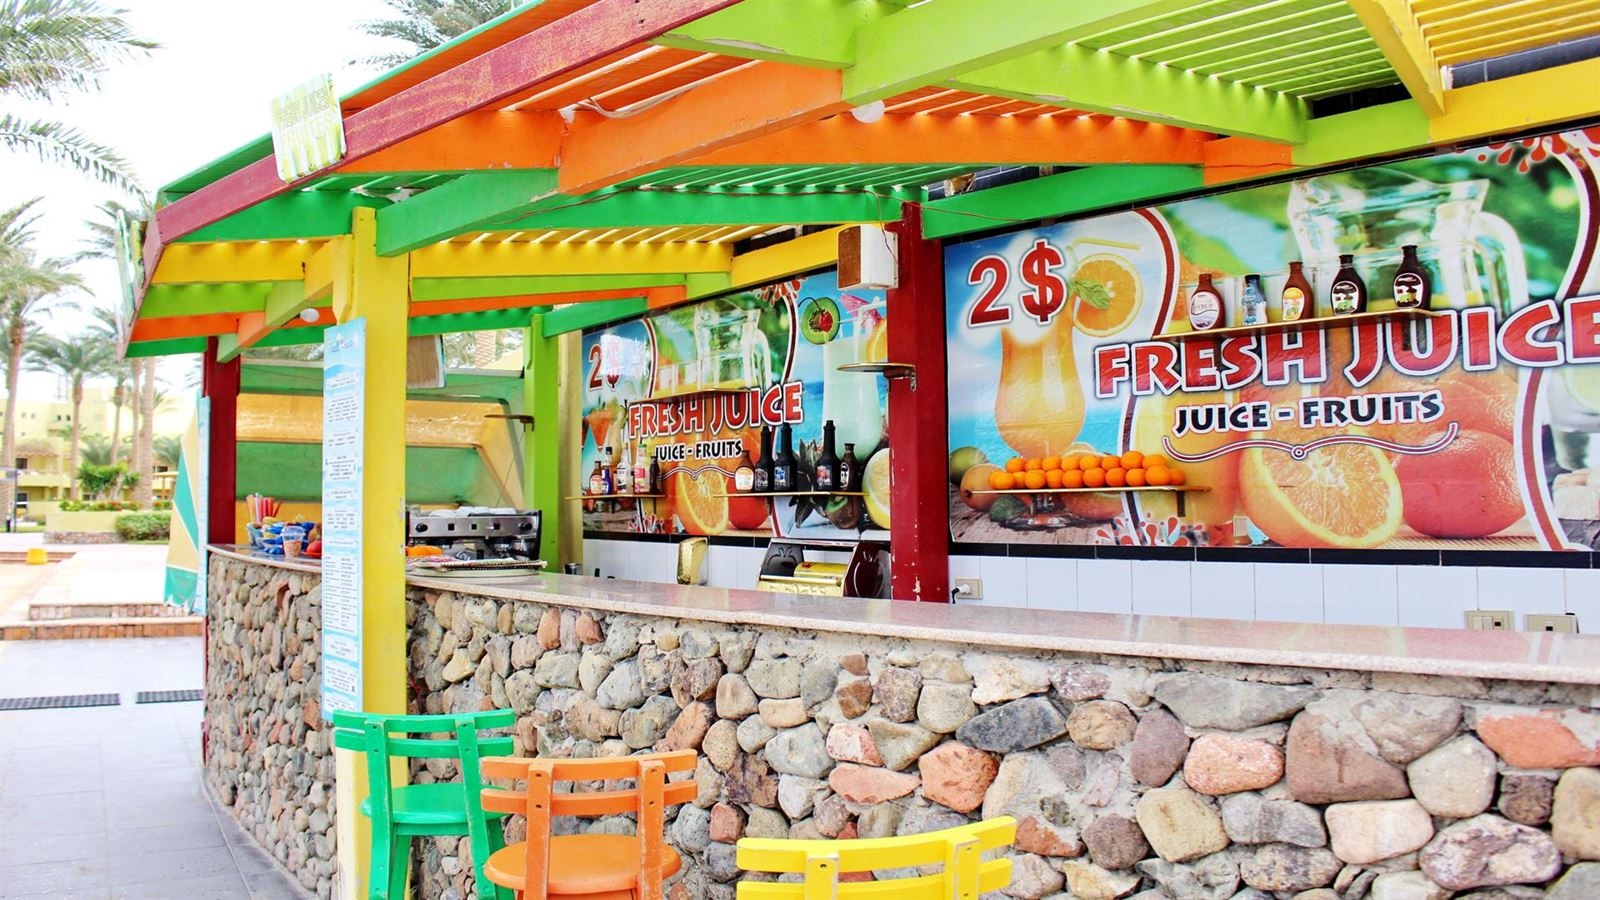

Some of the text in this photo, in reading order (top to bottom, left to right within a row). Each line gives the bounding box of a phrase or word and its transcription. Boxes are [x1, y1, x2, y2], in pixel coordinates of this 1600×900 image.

[1094, 331, 1329, 397] FRESH
[628, 382, 803, 439] FRESH JUICE
[1174, 402, 1270, 436] JUICE
[1302, 390, 1444, 428] FRUITS
[656, 443, 686, 461] JUICE
[695, 438, 742, 460] FRUITS
